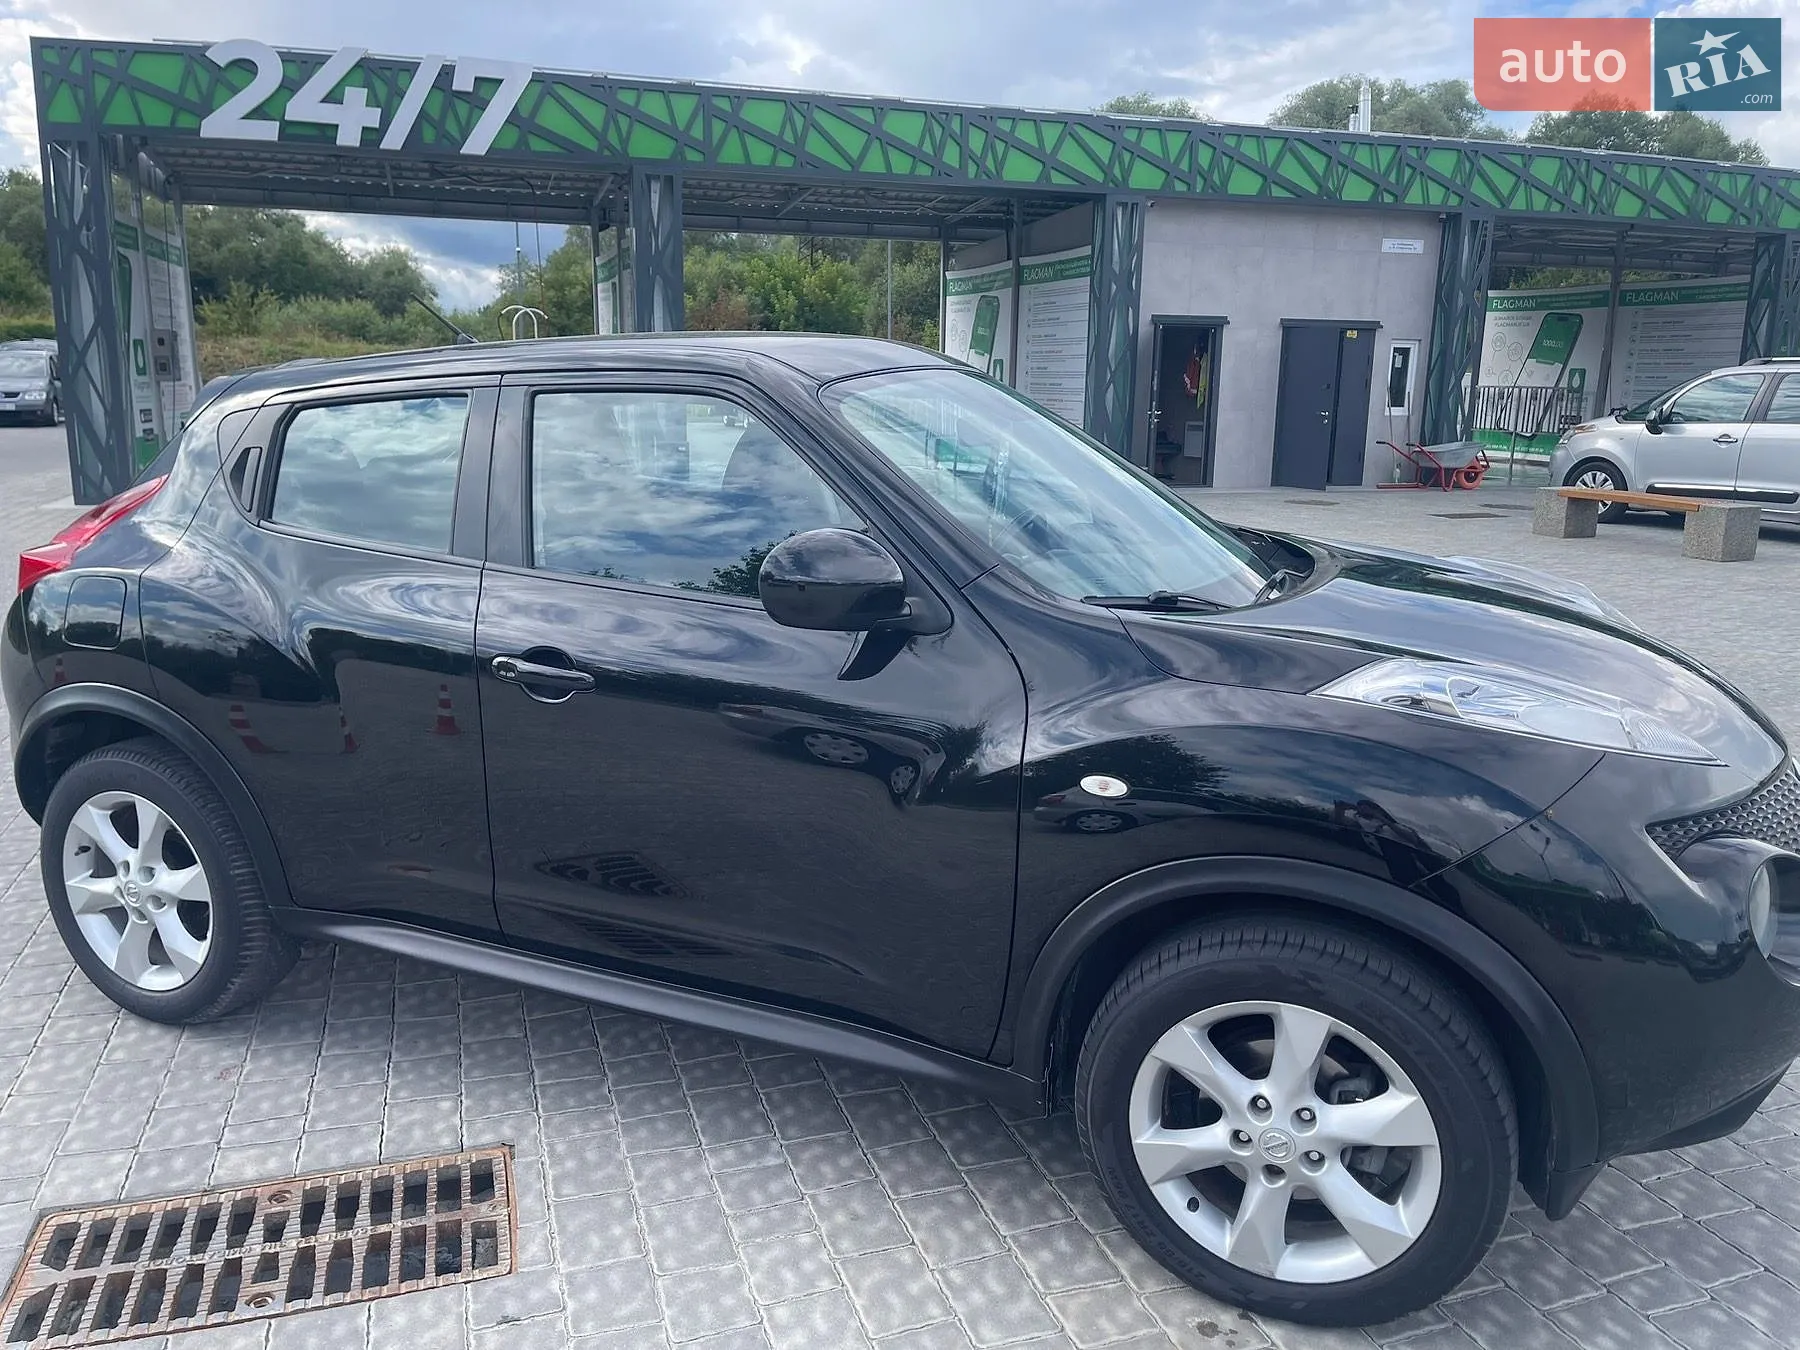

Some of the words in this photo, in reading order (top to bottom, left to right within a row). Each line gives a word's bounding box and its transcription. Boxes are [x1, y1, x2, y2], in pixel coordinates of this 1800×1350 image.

[200, 39, 534, 156] 24/7
[1626, 290, 1680, 302] FLAGMAN
[1492, 299, 1536, 309] FLAGMAN
